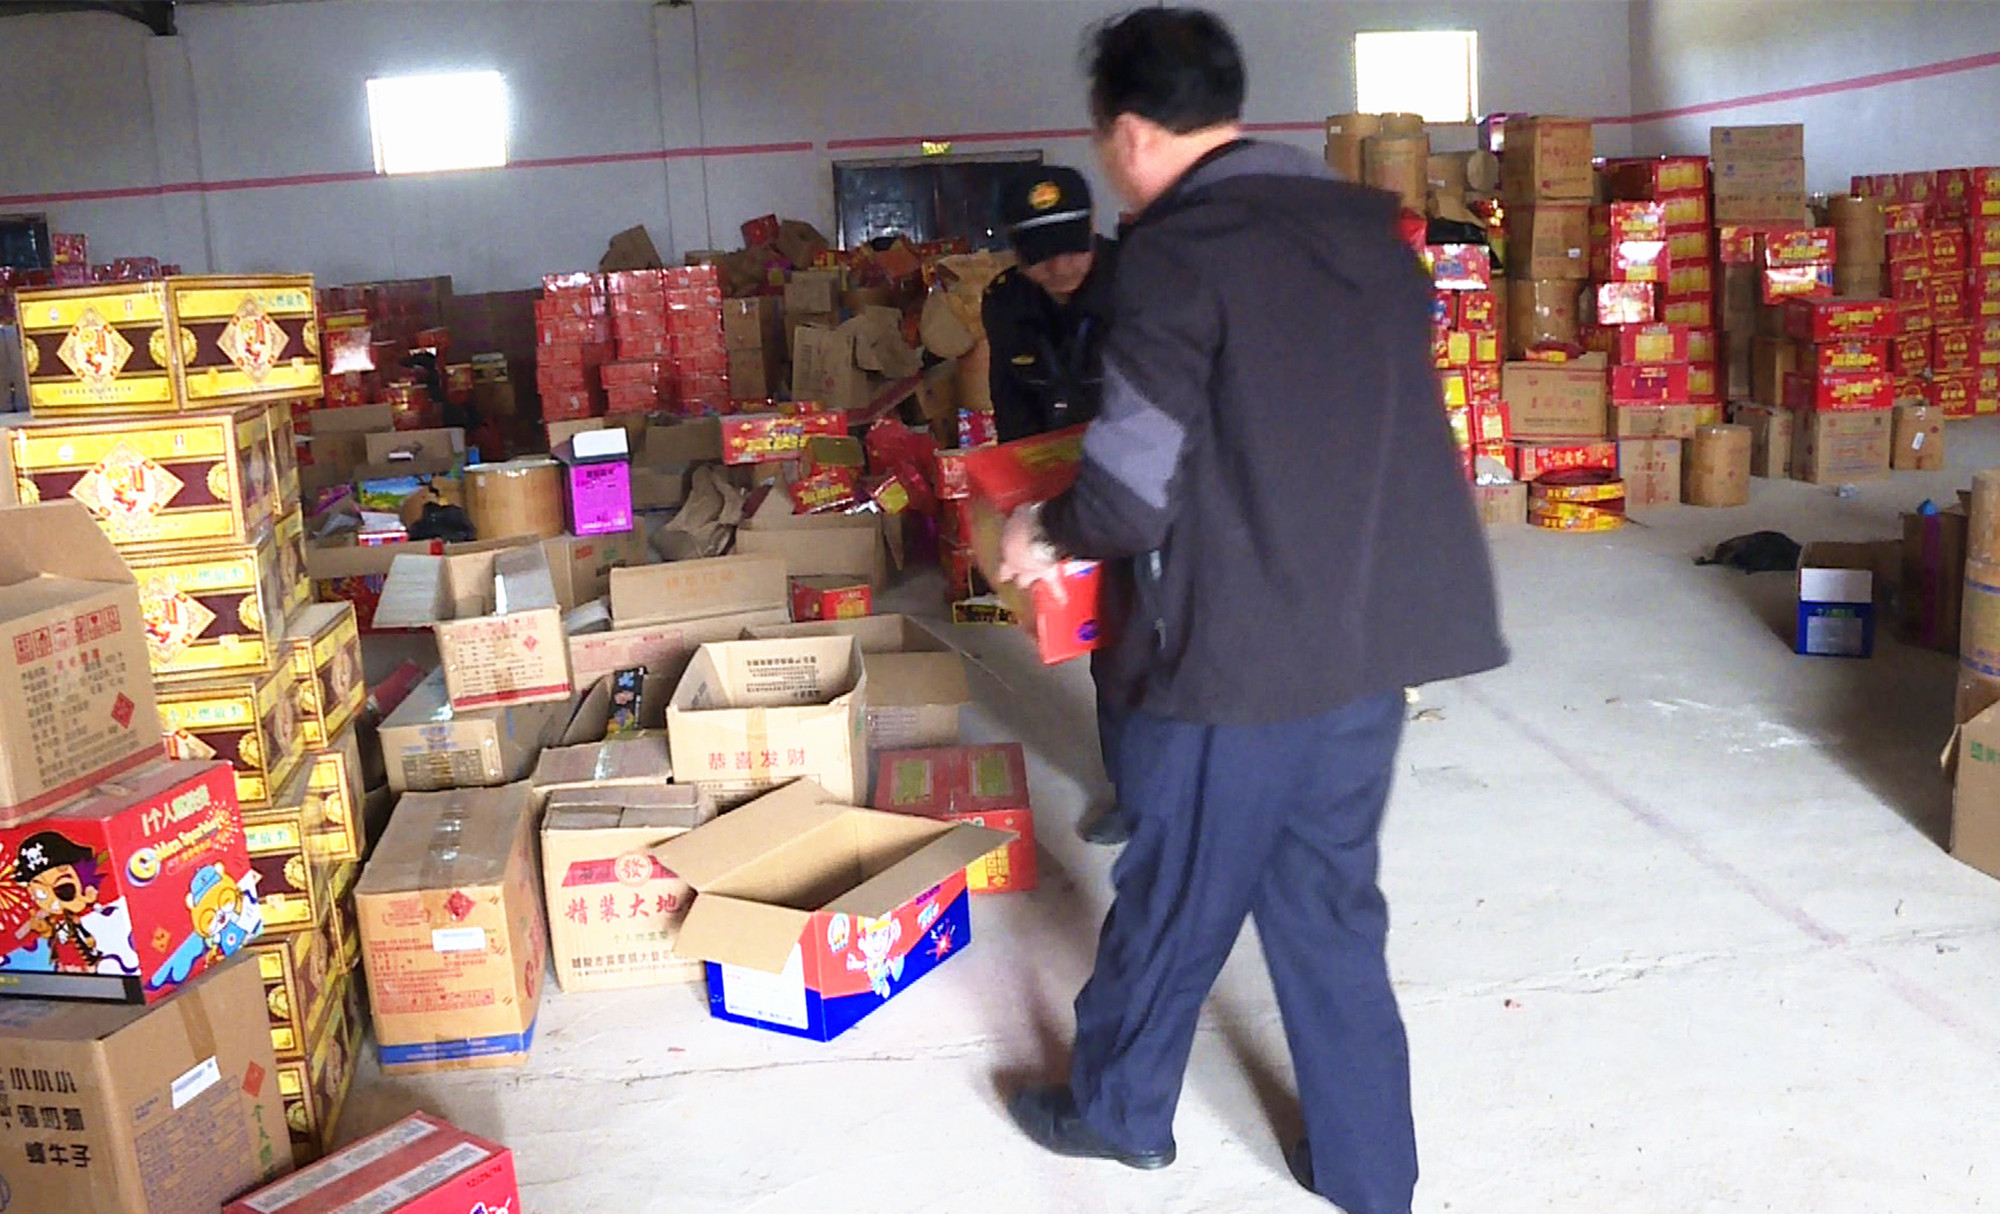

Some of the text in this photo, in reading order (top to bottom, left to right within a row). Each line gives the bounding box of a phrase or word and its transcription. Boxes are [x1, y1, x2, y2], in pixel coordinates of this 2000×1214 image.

[168, 705, 244, 723] 个人燃放类
[708, 747, 806, 770] 恭喜发财
